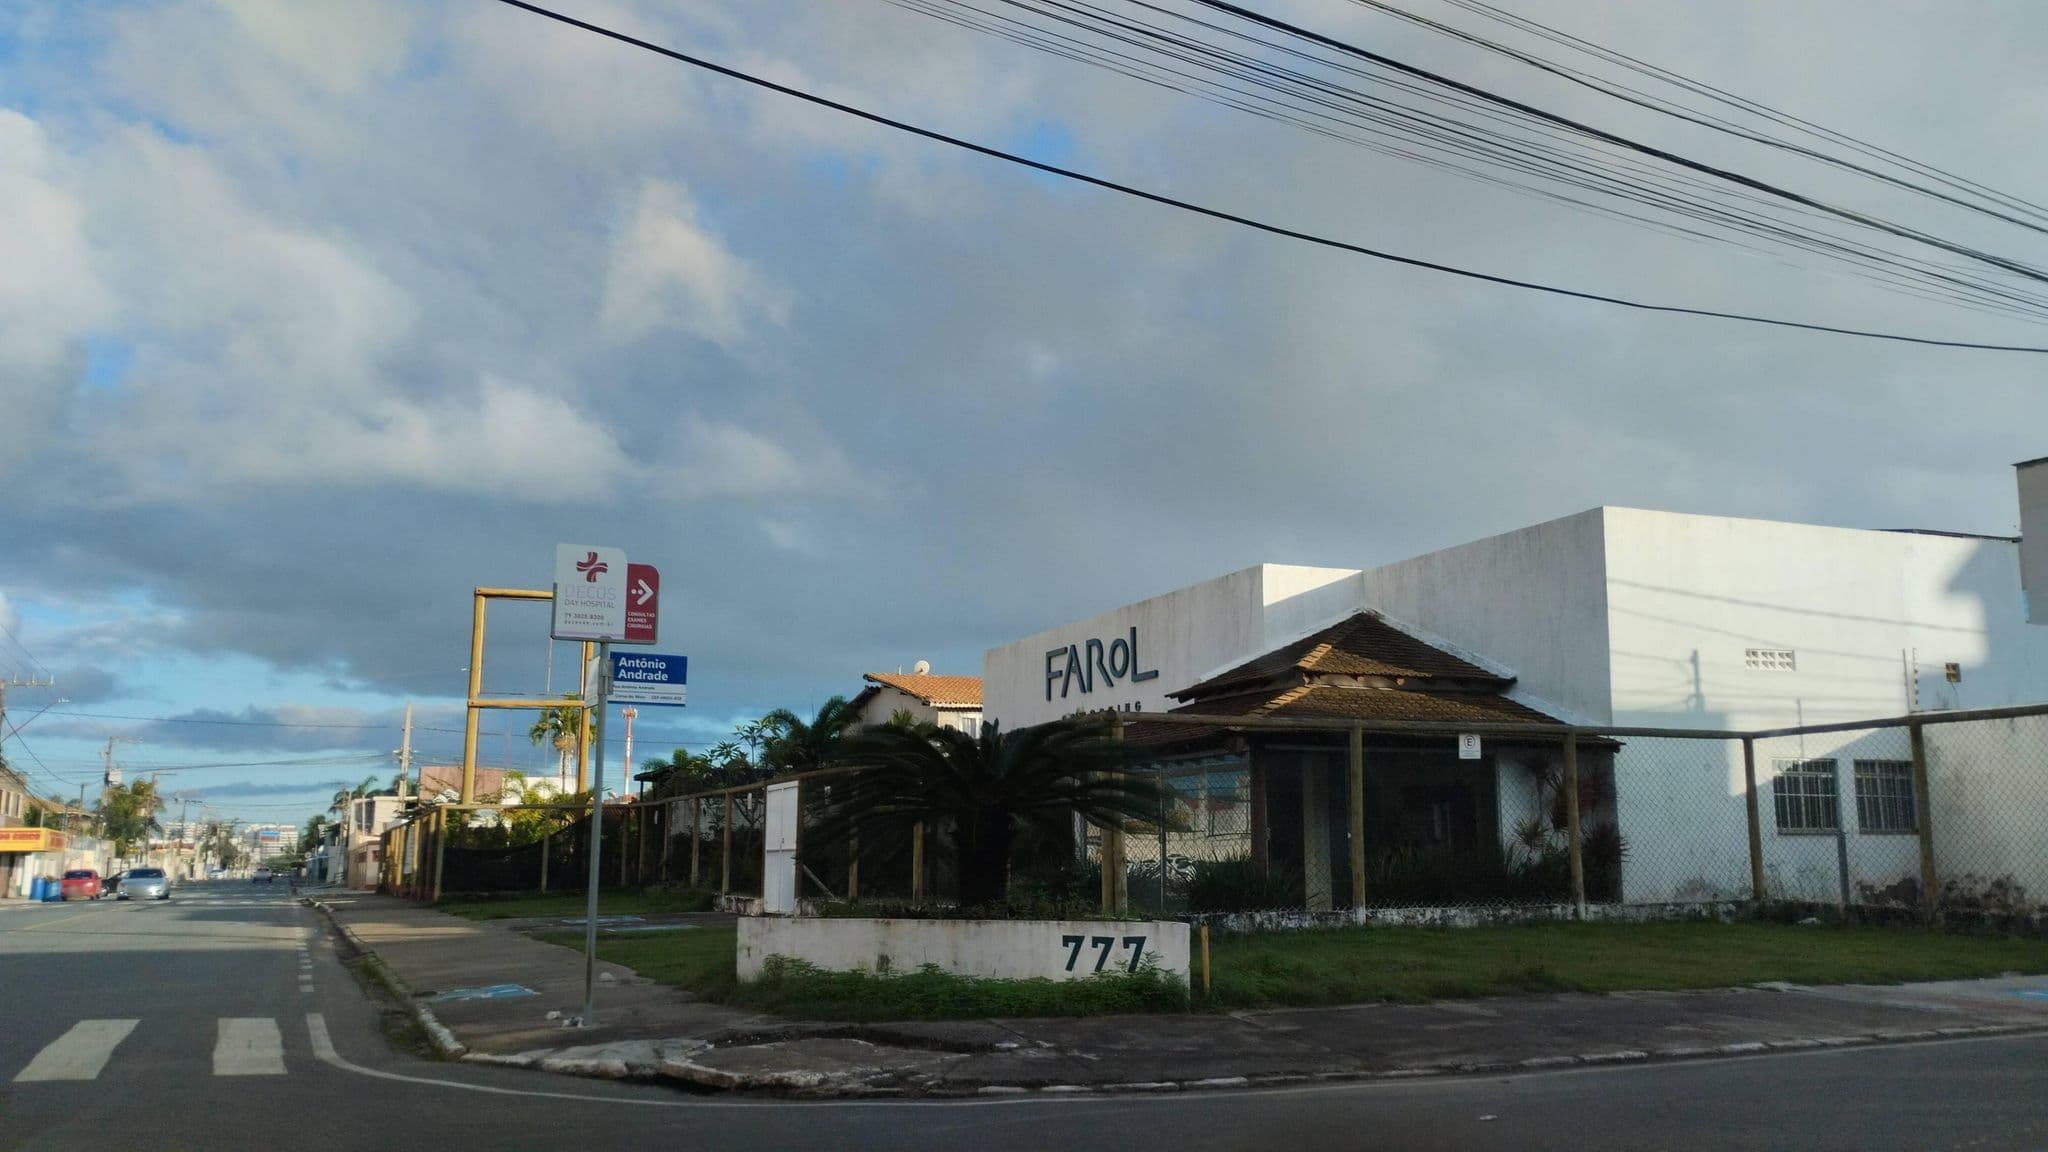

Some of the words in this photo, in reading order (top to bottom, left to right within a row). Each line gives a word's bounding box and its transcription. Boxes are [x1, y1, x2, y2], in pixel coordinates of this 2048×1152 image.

[581, 600, 615, 609] HOSPITAL
[618, 656, 667, 669] Antônio
[1046, 626, 1159, 702] FAROL
[617, 669, 669, 681] Andrade
[1062, 935, 1147, 973] 777
